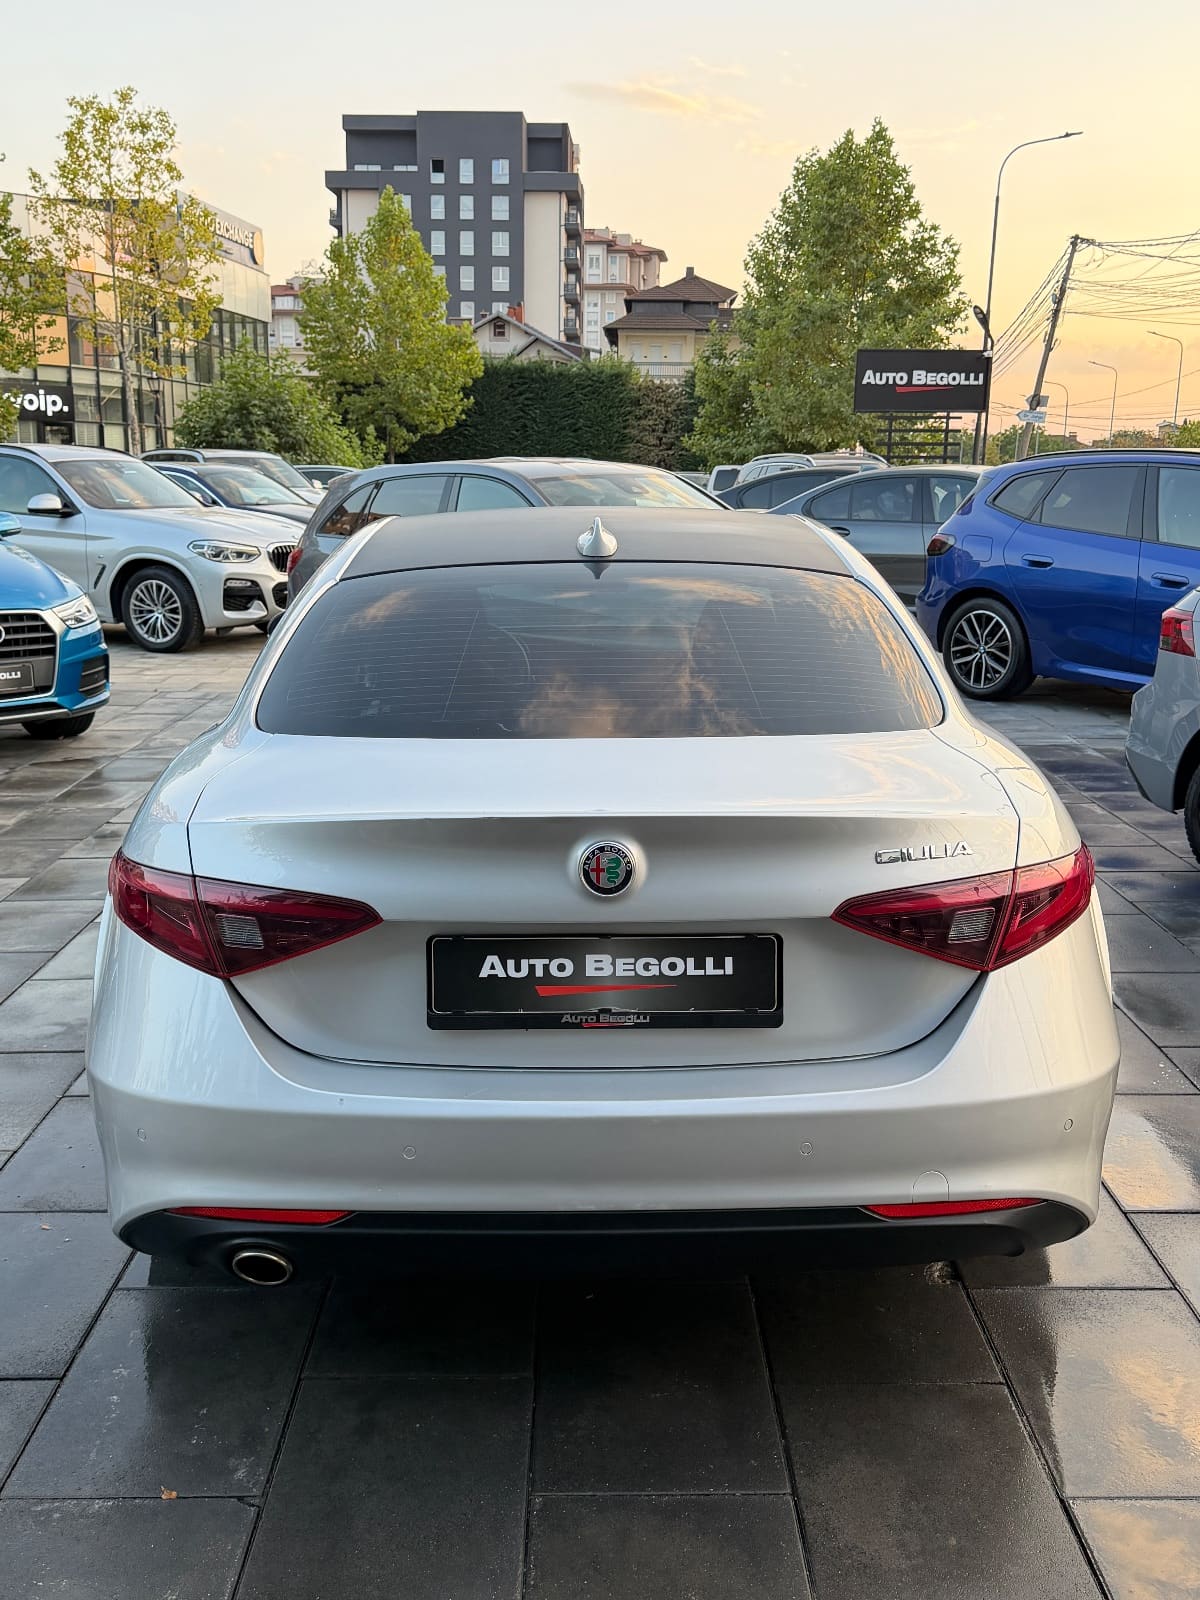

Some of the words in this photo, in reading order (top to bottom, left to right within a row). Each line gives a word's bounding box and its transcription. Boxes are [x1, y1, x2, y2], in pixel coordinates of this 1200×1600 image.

[215, 218, 254, 249] EXCHANGE
[861, 369, 908, 385] AUTO
[912, 370, 984, 385] BEGOLLI
[583, 849, 601, 870] ALFA
[604, 845, 632, 870] ROMEO
[875, 841, 974, 864] GIULIA
[478, 954, 574, 978] AUTO
[585, 954, 734, 977] BEGOLLI
[560, 1013, 597, 1023] AUTO
[599, 1013, 650, 1023] BEGOLLI
